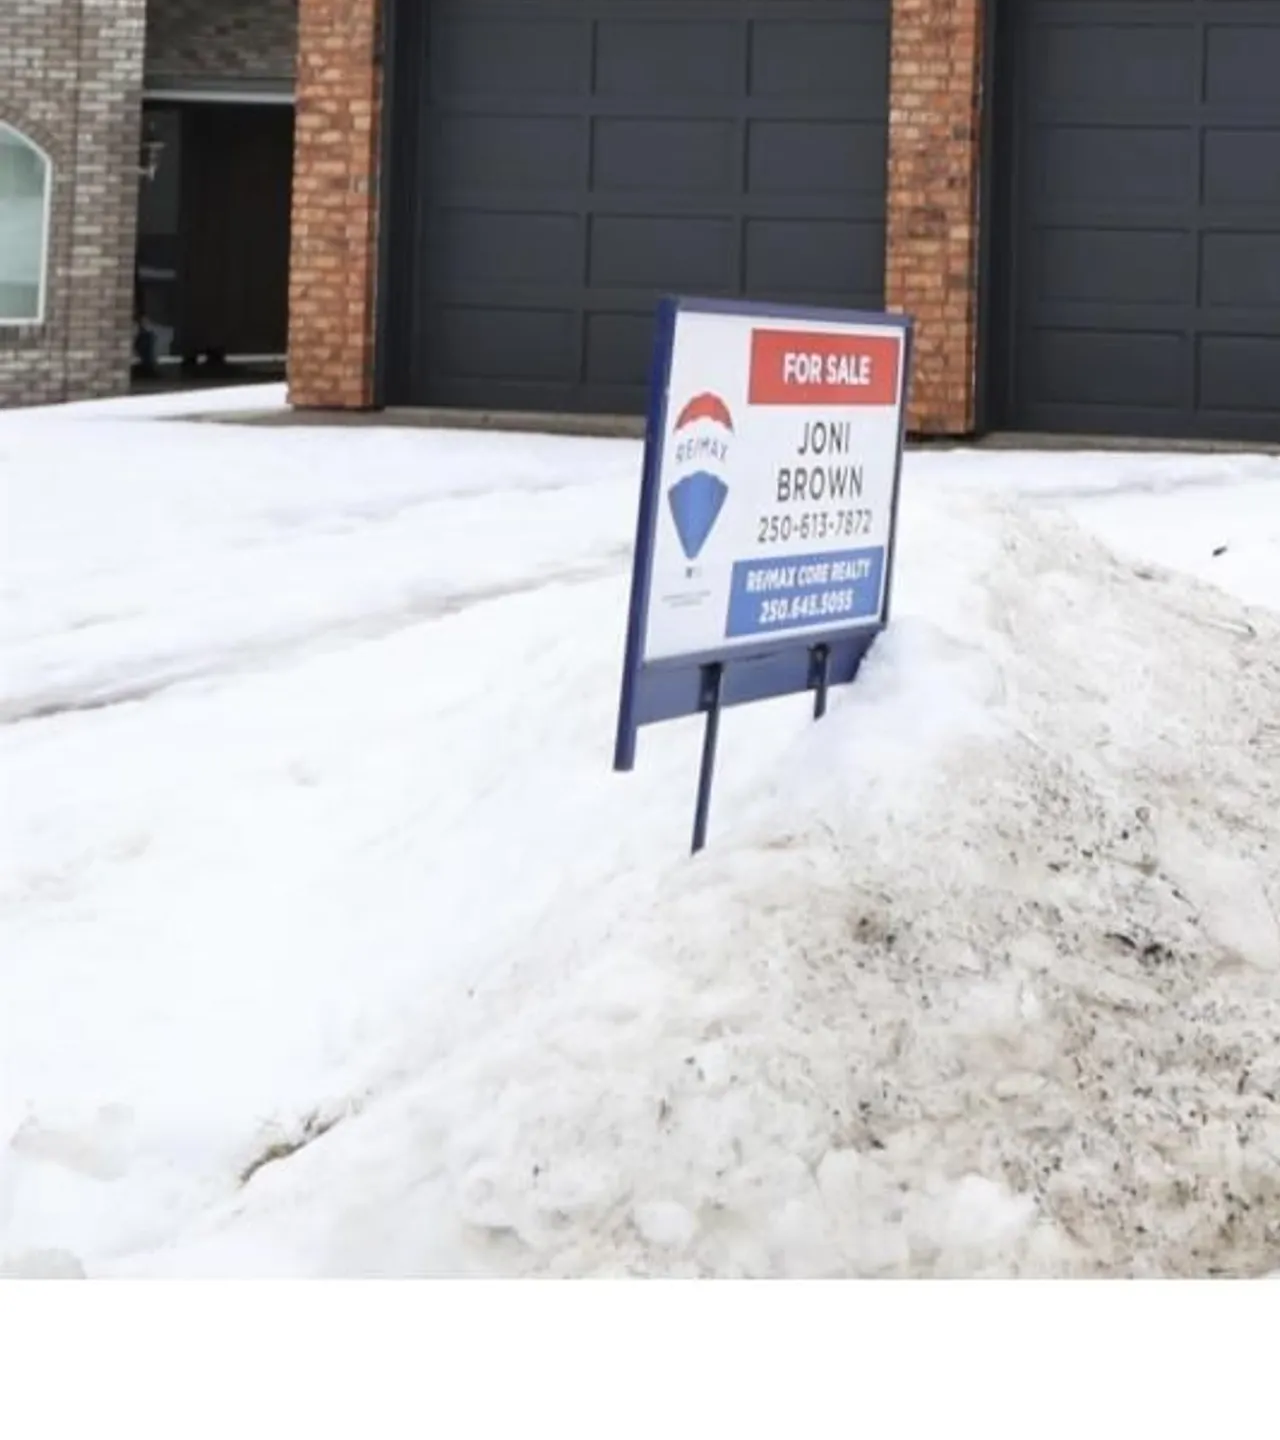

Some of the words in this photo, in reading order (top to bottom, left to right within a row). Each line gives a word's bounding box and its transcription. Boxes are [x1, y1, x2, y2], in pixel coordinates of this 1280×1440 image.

[783, 352, 822, 384] FOR
[825, 354, 871, 385] SALE
[797, 421, 852, 454] JONI
[776, 465, 864, 502] BROWN
[757, 509, 873, 543] 250-613-7872
[797, 561, 829, 586] CORE
[831, 558, 872, 582] REALTY
